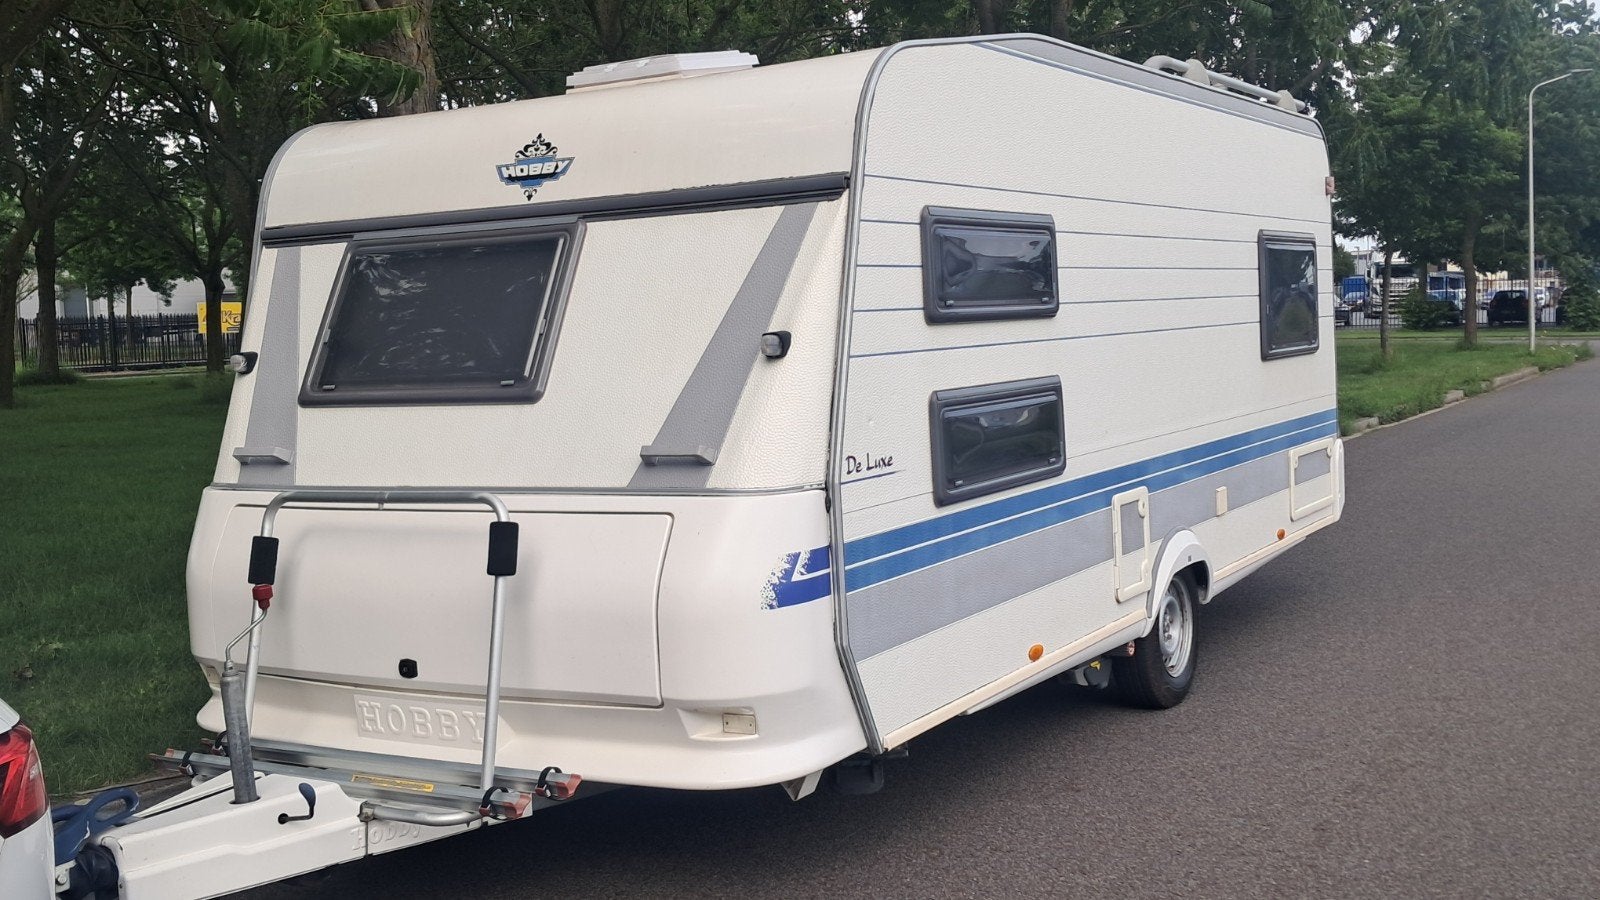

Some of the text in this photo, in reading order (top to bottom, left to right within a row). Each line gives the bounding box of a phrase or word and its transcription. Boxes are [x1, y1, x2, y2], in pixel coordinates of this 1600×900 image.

[501, 160, 570, 178] HOBBY
[845, 452, 894, 475] De Luxe
[357, 699, 486, 743] HOBBY
